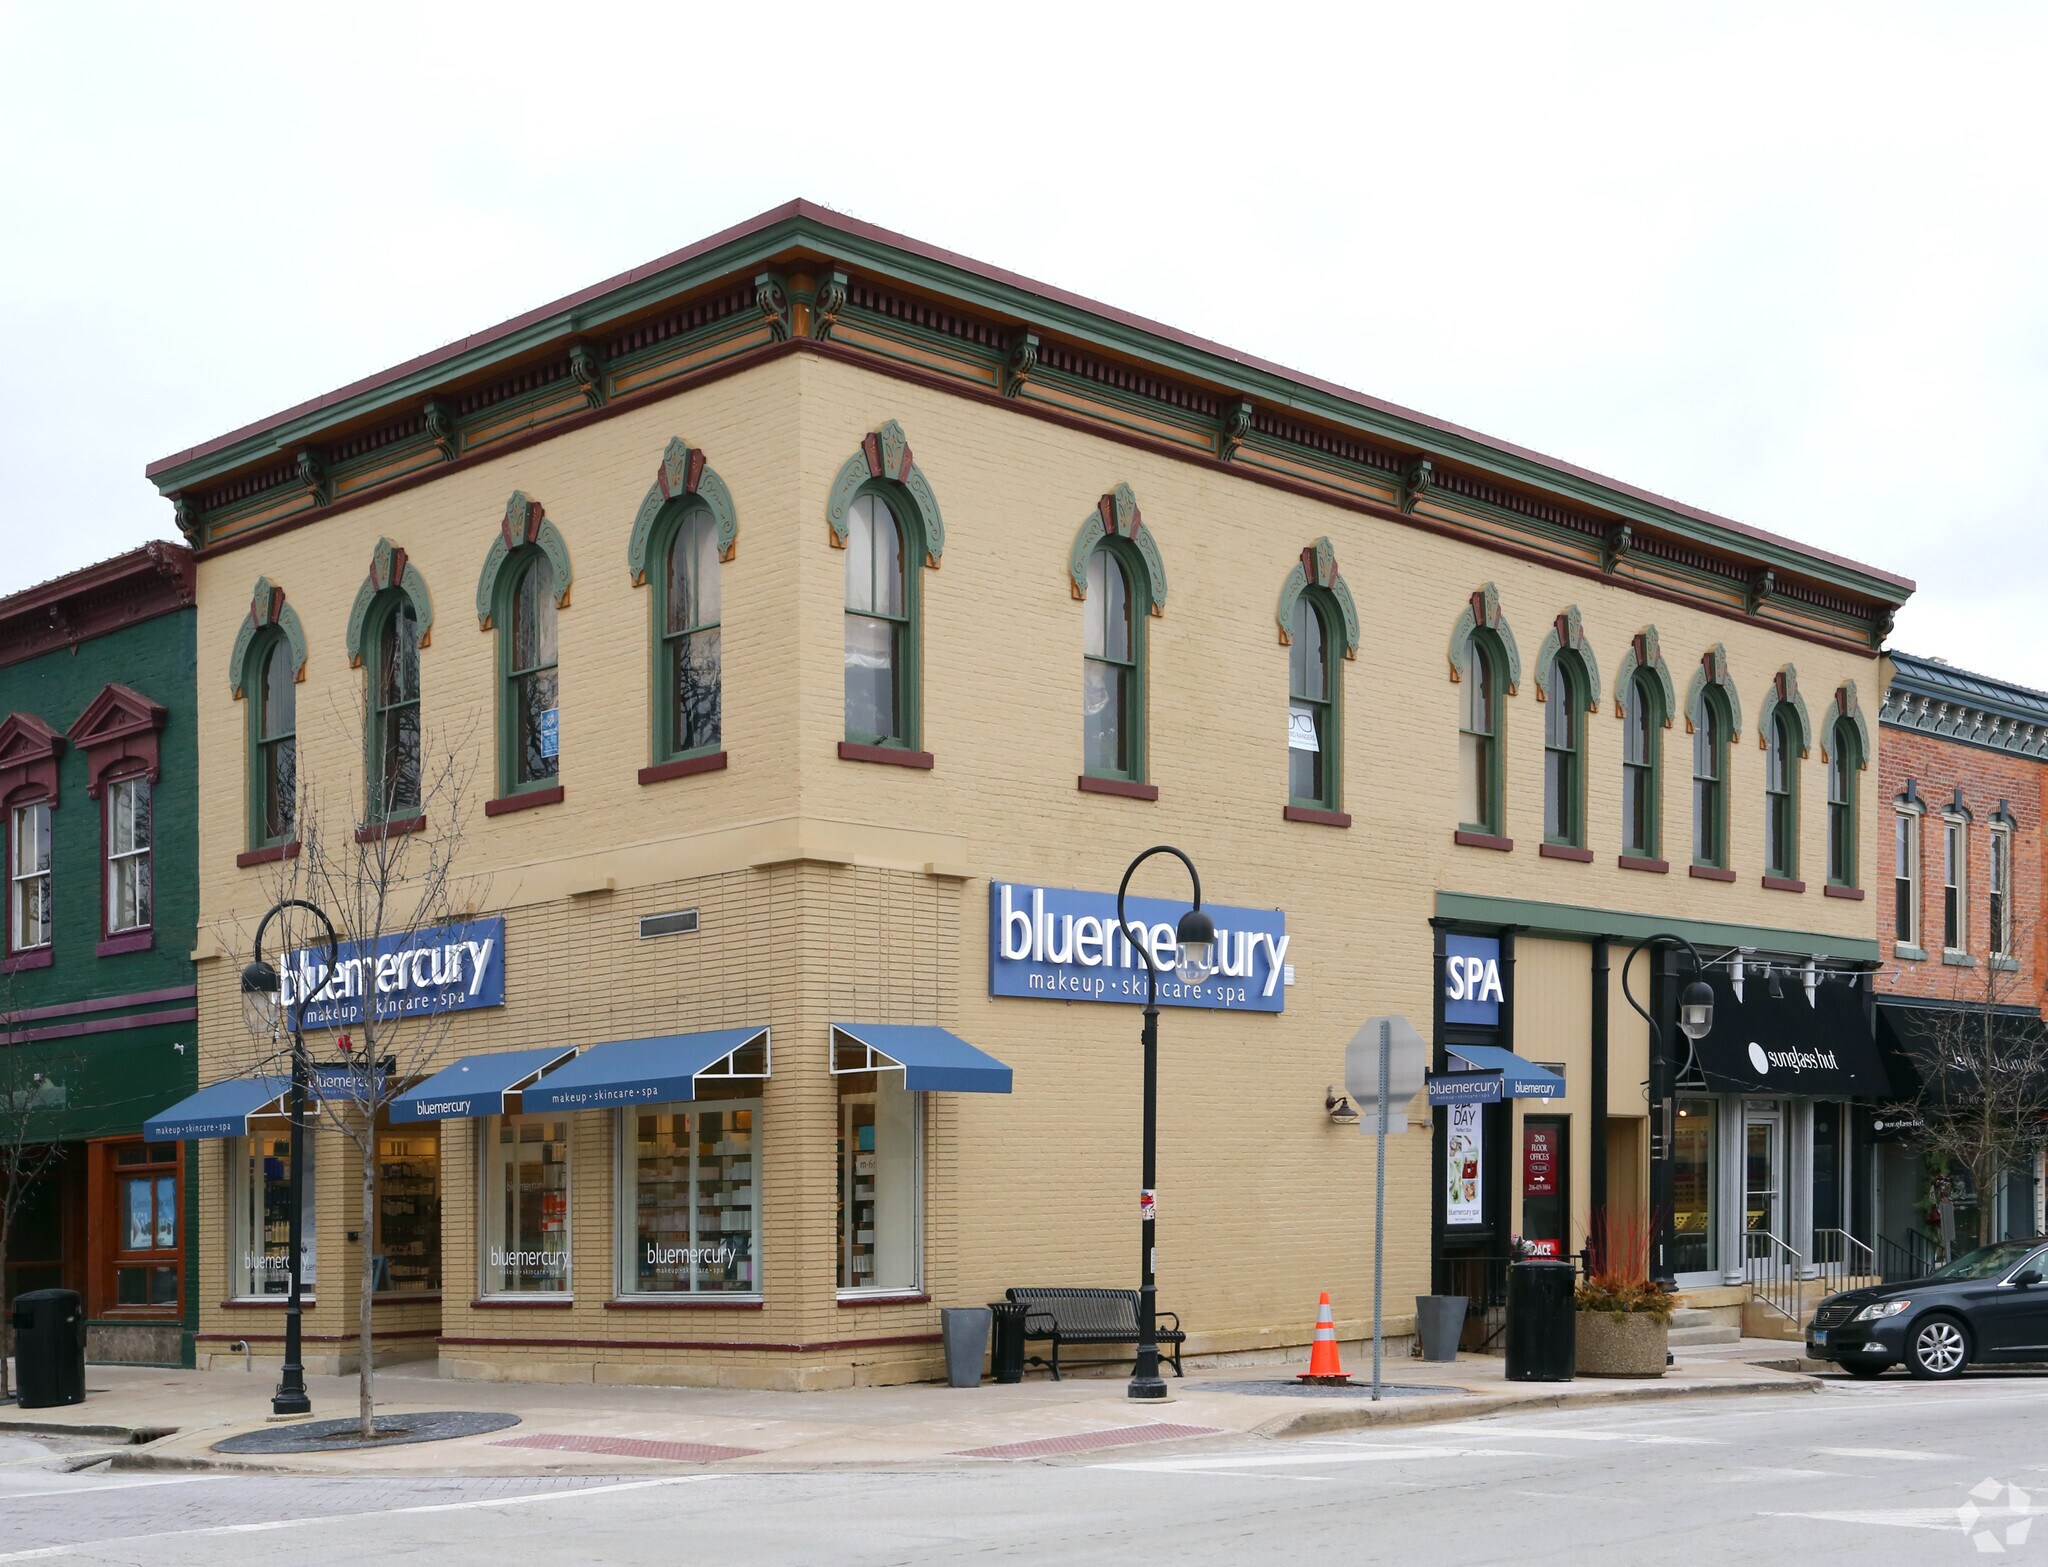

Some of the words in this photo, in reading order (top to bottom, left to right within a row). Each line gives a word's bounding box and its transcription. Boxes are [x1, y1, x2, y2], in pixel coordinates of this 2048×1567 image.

[279, 938, 494, 1006] bluemercury
[1446, 955, 1505, 1002] SPA
[1029, 970, 1105, 998] makeup
[1216, 985, 1246, 1007] spa
[307, 1004, 357, 1023] makeup
[374, 993, 429, 1014] kincare
[440, 991, 466, 1009] spa
[1767, 1045, 1818, 1074] sunglass
[1815, 1047, 1839, 1069] hut
[308, 1074, 385, 1091] bluemercy
[1429, 1081, 1500, 1095] bluemercury
[1515, 1081, 1555, 1096] bluemercury
[552, 1089, 587, 1103] makeup
[594, 1087, 634, 1101] skincare
[641, 1086, 658, 1098] spa
[417, 1099, 471, 1115] bluemercury
[1454, 1110, 1476, 1125] DAY
[155, 1125, 181, 1135] makeup
[185, 1123, 214, 1133] skincare
[219, 1123, 231, 1132] spa
[1534, 1134, 1545, 1142] 2ND
[1529, 1152, 1550, 1161] OFFICES
[491, 1246, 569, 1270] bluemercury
[647, 1242, 736, 1269] bluemercury
[1531, 1243, 1551, 1256] PACE
[244, 1250, 309, 1272] bluemercy
[656, 1266, 679, 1274] makeup
[683, 1266, 709, 1274] skcare
